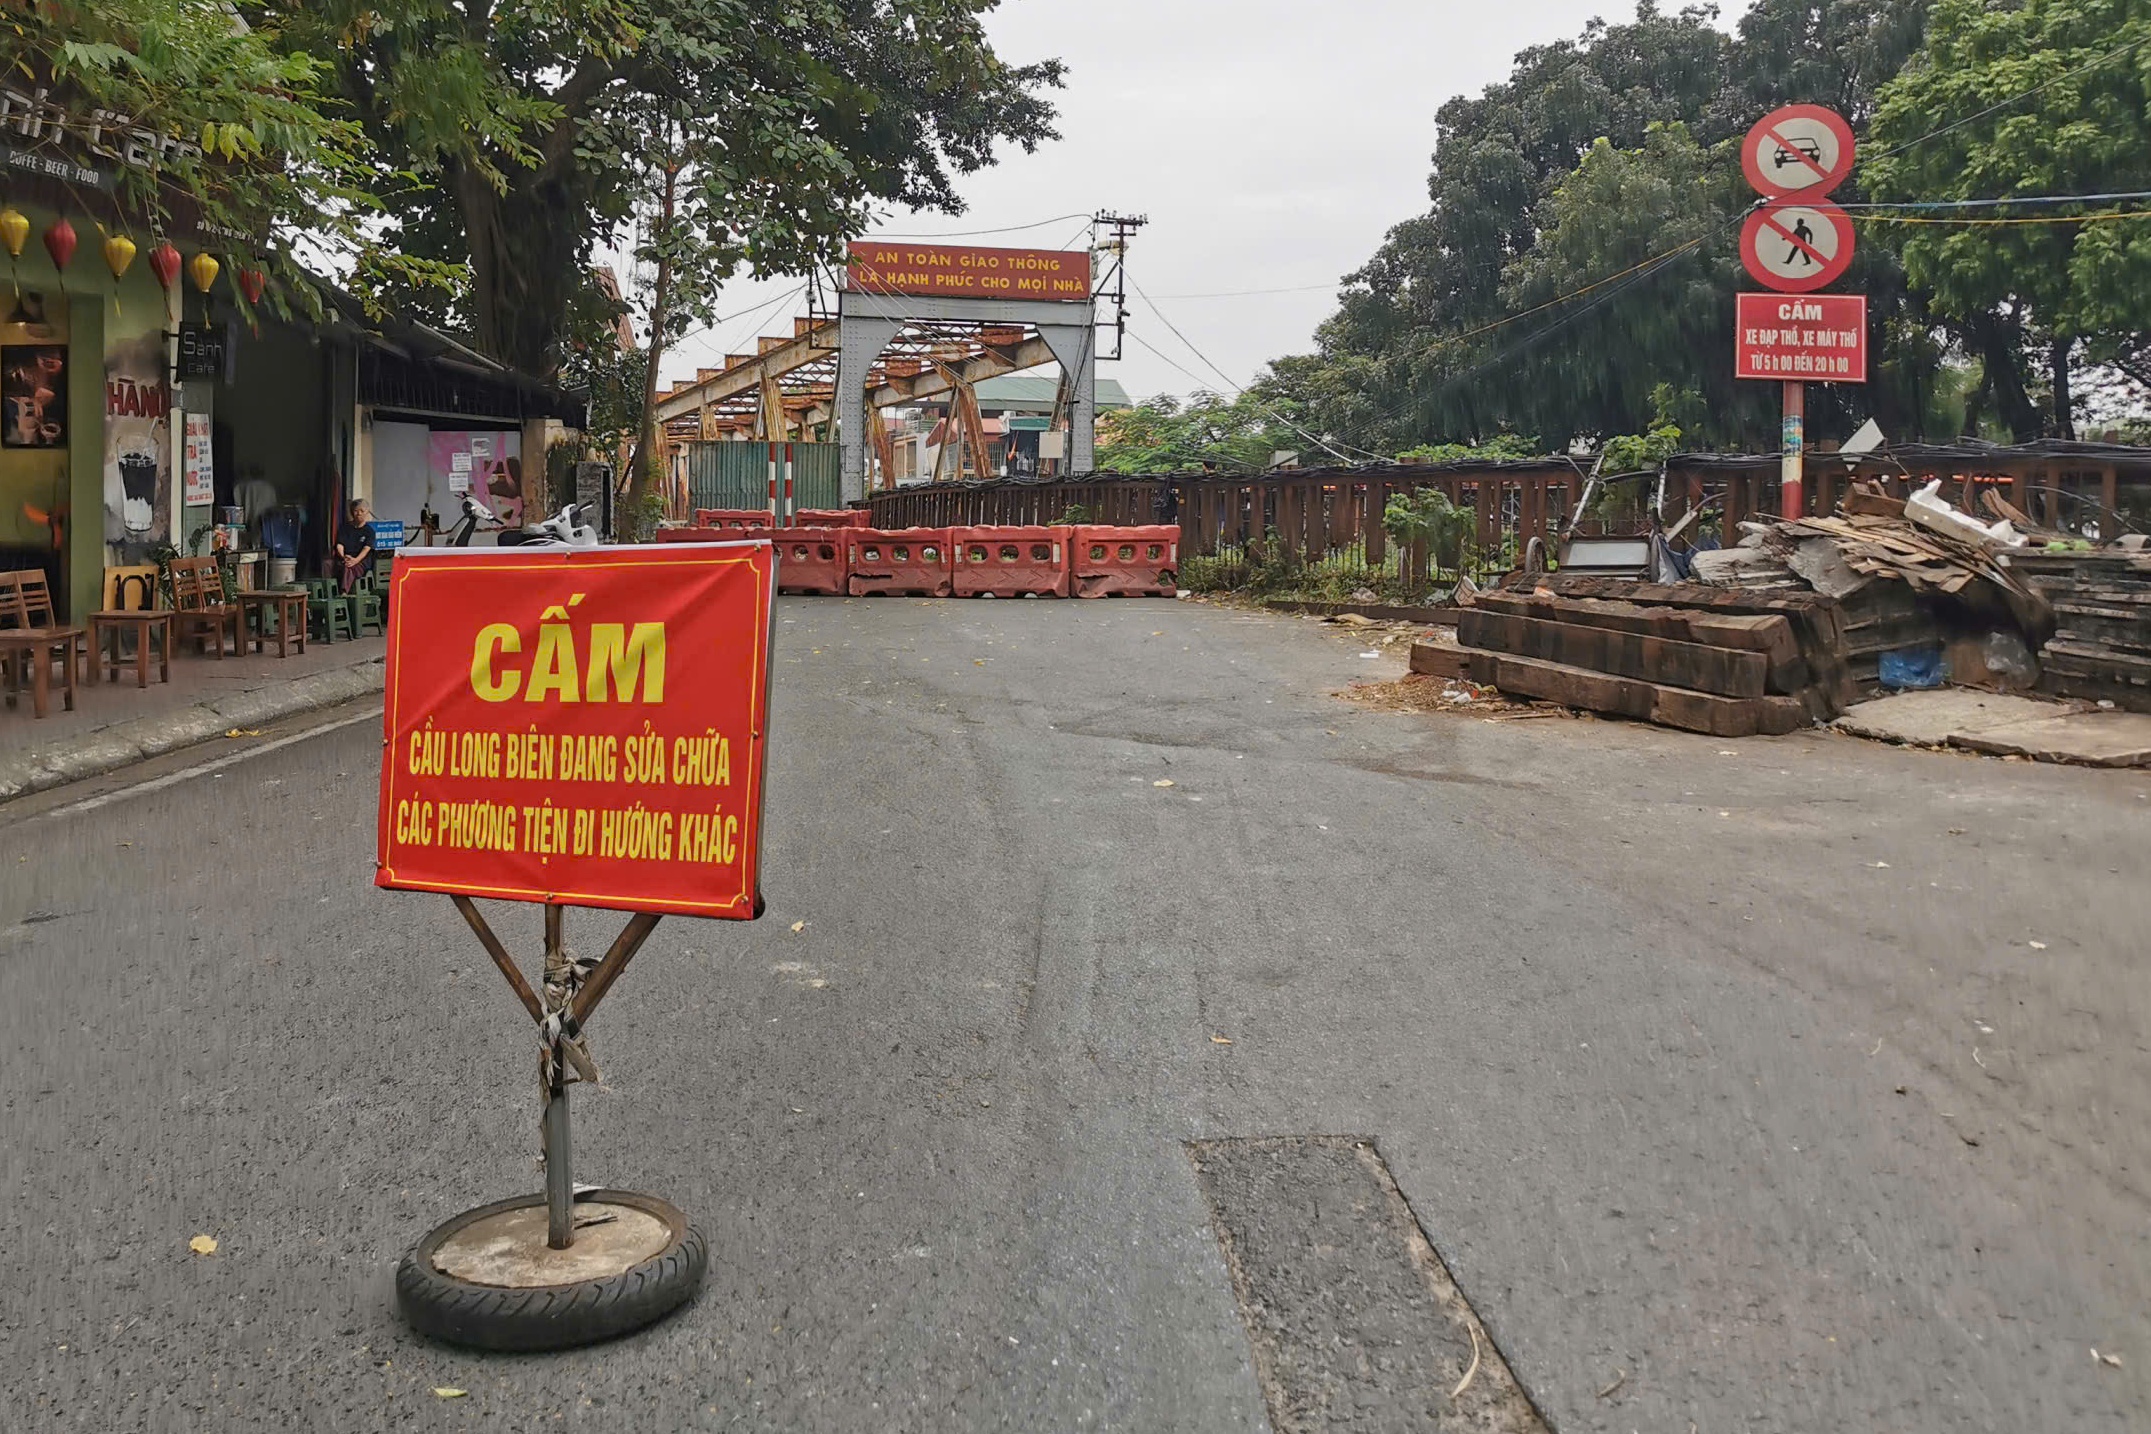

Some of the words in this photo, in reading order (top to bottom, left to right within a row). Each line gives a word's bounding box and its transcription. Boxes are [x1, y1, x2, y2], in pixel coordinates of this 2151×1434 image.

[45, 159, 69, 178] BEER
[75, 169, 99, 185] FOOD
[874, 252, 899, 264] AN
[907, 250, 951, 266] TOÀN
[1007, 254, 1060, 271] THÔNG
[886, 271, 929, 288] HẠNH
[935, 270, 974, 287] PHÚC
[981, 276, 1010, 289] CHO
[1053, 276, 1084, 292] NHÀ
[1778, 298, 1822, 321] CẤM
[1745, 329, 1758, 345] XE
[1759, 329, 1779, 349] ĐẠP
[1802, 330, 1815, 346] XE
[1816, 328, 1837, 347] MÁY
[1750, 350, 1764, 371] TỪ
[1764, 355, 1771, 370] 5
[1772, 354, 1779, 371] h
[1780, 355, 1792, 371] 00
[1794, 350, 1813, 372] ĐẾN
[1815, 356, 1827, 372] 20
[1828, 356, 1835, 372] h
[1836, 357, 1849, 373] 00
[470, 593, 666, 703] CẤM
[409, 716, 447, 776] CẦU
[450, 731, 501, 778] LONG
[506, 724, 555, 780] BIÊN
[559, 734, 617, 783] ĐANG
[623, 719, 666, 784] SỬA
[672, 727, 731, 786] CHỮA
[396, 791, 433, 846] CÁC
[437, 799, 517, 851] PHƯƠNG
[523, 797, 568, 864] TIỆN
[573, 808, 595, 856] ĐI
[600, 800, 673, 861] HƯỚNG
[678, 804, 738, 864] KHÁC
